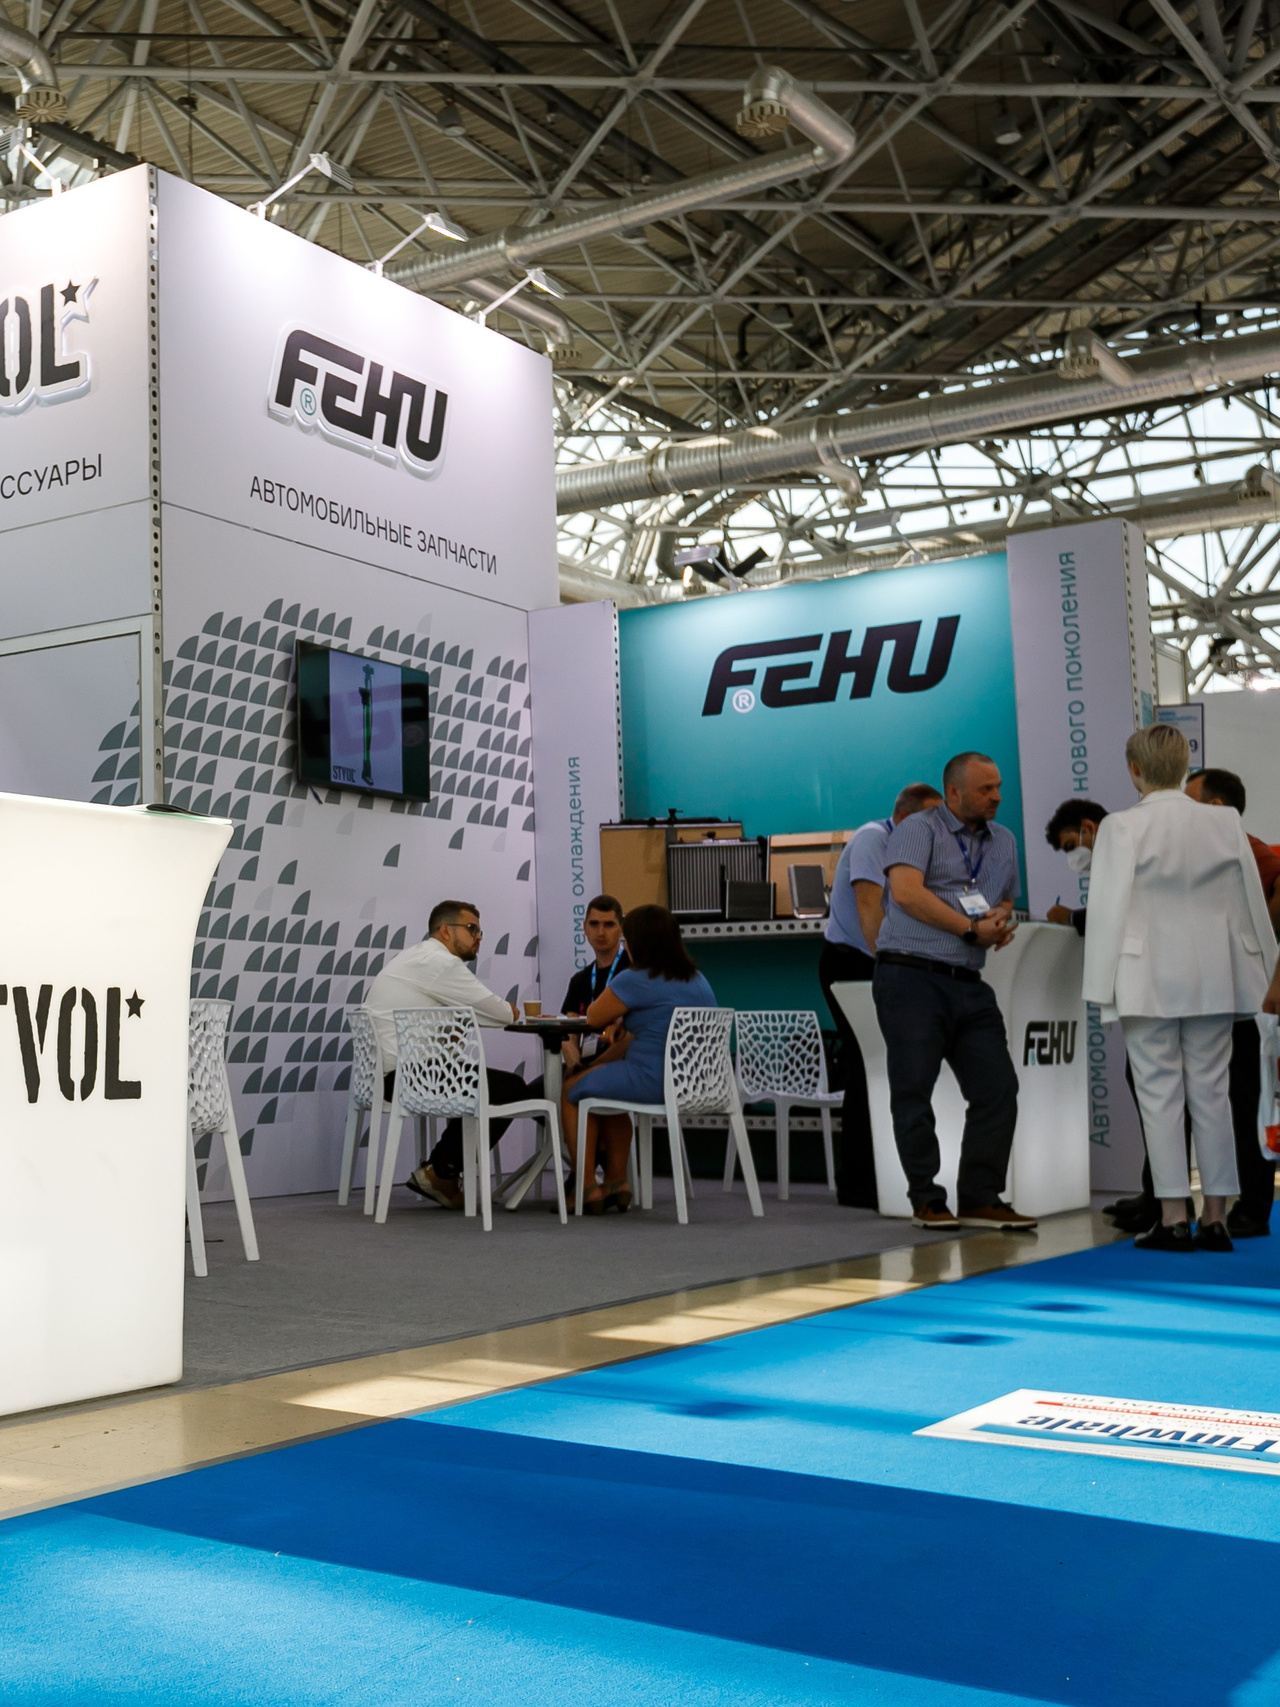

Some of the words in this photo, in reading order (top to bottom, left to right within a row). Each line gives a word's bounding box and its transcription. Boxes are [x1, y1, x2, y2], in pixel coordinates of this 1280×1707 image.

[274, 328, 449, 462] FEHU
[250, 475, 413, 549] АВТОМОБИЛЬНЫЕ
[417, 529, 498, 576] ЗАПЧАСТИ
[701, 614, 961, 717] FEHU
[1058, 551, 1084, 692] поколения
[332, 765, 356, 783] STVOL
[1067, 699, 1089, 792] нового
[568, 756, 585, 897] охлаждения
[1022, 1020, 1077, 1067] FEHU
[1016, 1415, 1279, 1453] Finwhale
